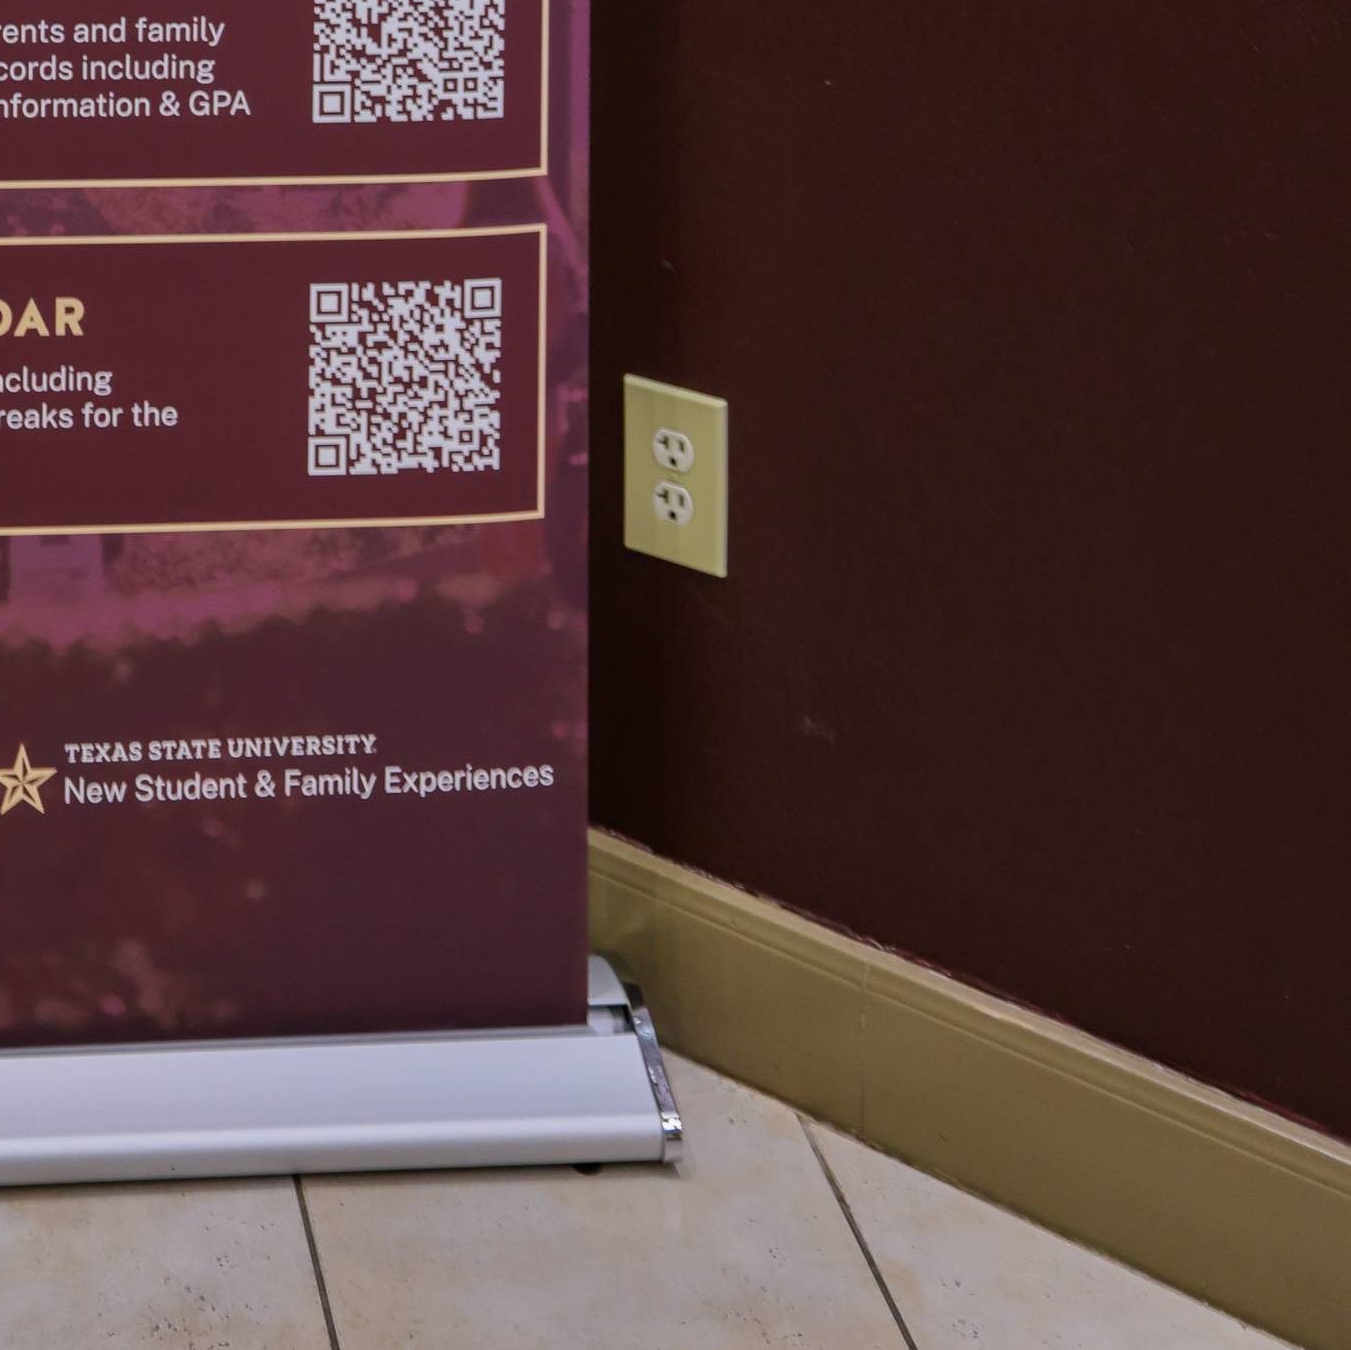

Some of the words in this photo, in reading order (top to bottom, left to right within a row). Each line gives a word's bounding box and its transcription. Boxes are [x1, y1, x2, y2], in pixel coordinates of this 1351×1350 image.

[73, 15, 127, 45] and
[134, 15, 226, 48] family
[82, 52, 216, 86] including
[158, 89, 181, 117] &
[188, 88, 251, 117] GPA
[81, 400, 124, 429] for
[131, 399, 179, 428] the
[64, 740, 143, 764] TEXAS
[148, 738, 222, 762] STATE
[226, 733, 377, 759] UNIVERSITY
[64, 775, 128, 806] New
[134, 770, 248, 803] Student
[254, 769, 276, 799] &
[284, 765, 378, 800] Family
[384, 762, 554, 798] Experiences
